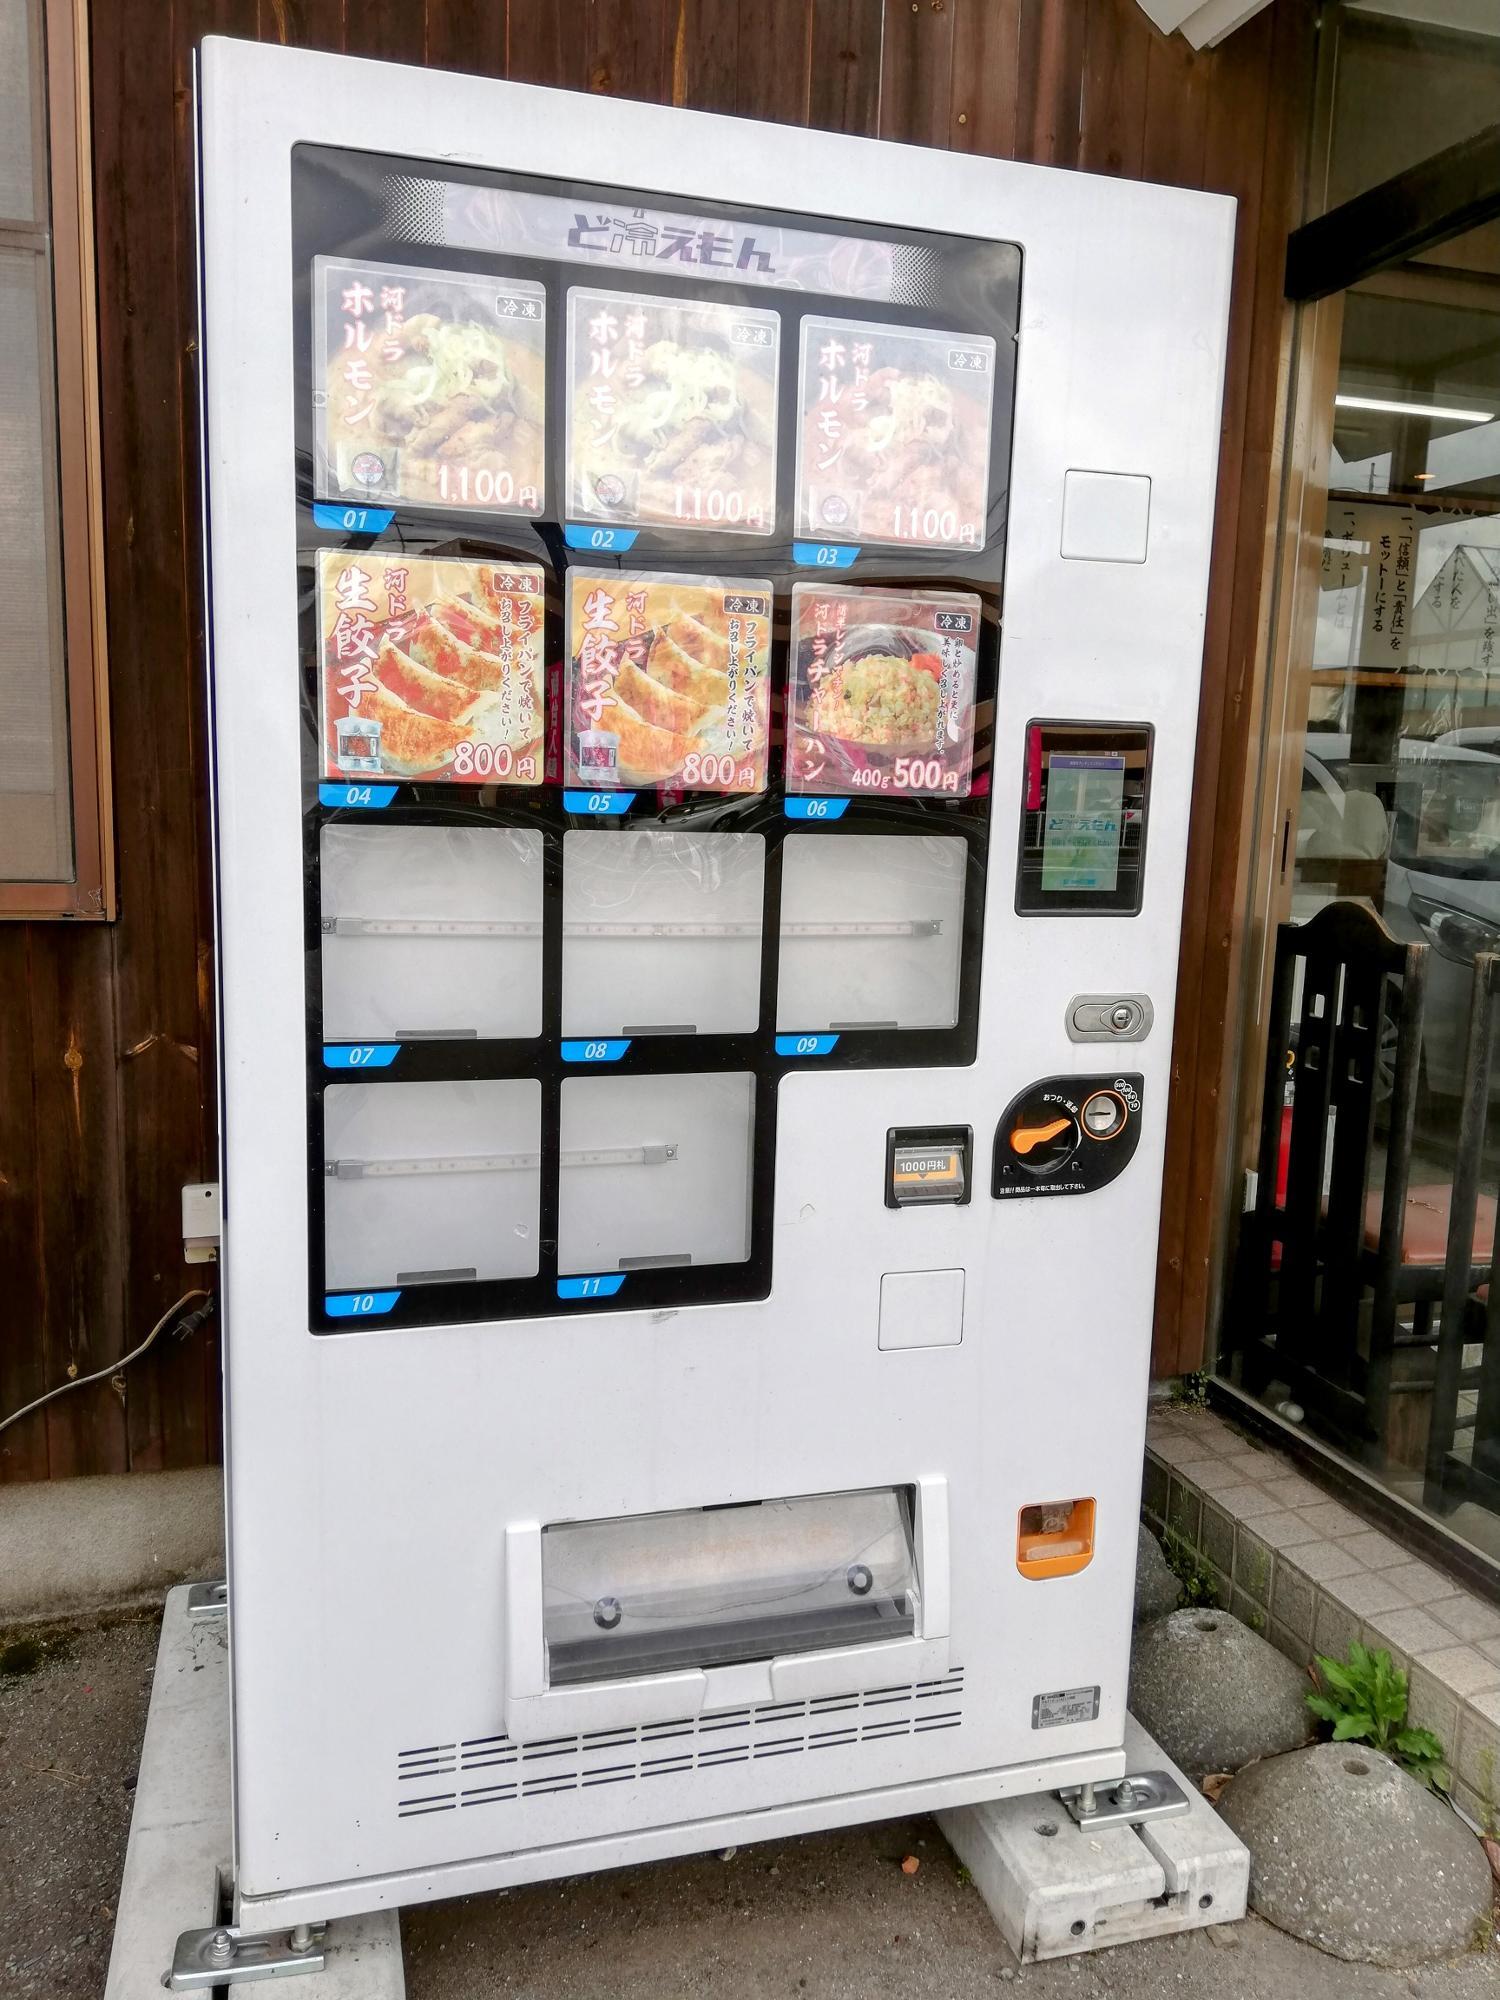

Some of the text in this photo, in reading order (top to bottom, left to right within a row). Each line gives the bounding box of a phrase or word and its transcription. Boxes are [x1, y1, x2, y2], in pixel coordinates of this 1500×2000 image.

[567, 208, 777, 275] ど冷えもん
[380, 285, 407, 362] 河ドラ
[499, 298, 539, 319] 冷凍
[624, 314, 648, 387] 河ドラ
[735, 326, 768, 345] 冷凍
[341, 281, 377, 427] ホルモン
[953, 352, 983, 370] 冷凍
[589, 310, 620, 448] ホルモン
[851, 342, 874, 412] 河ドラ
[816, 339, 847, 471] ホルモン
[437, 464, 540, 510] 1,100円
[342, 509, 369, 529] 01
[673, 485, 764, 529] 1,100円
[590, 530, 615, 548] 02
[816, 547, 838, 565] 03
[499, 575, 534, 593] 冷凍
[1372, 535, 1392, 633] モットーにする
[383, 567, 410, 643] 河ドラ
[729, 598, 760, 613] 冷凍
[939, 615, 968, 630] 冷凍
[333, 564, 381, 711] 生餃子
[624, 590, 649, 660] 河ドラ
[517, 600, 535, 742] フライパンで焼いて
[577, 587, 621, 723] 生餃子
[742, 620, 758, 752] フライパンで焼いて
[804, 603, 831, 782] 河ドラチャーハン
[453, 740, 537, 780] 800円
[681, 752, 755, 789] 800円
[851, 757, 960, 792] 400g 500円
[345, 787, 371, 805] 04
[587, 794, 612, 812] 05
[805, 800, 828, 817] 06
[348, 1047, 374, 1065] 07
[583, 1042, 608, 1060] 08
[795, 1036, 818, 1054] 09
[900, 1160, 947, 1173] 1000円札
[351, 1295, 374, 1313] 10
[581, 1278, 601, 1296] 11
